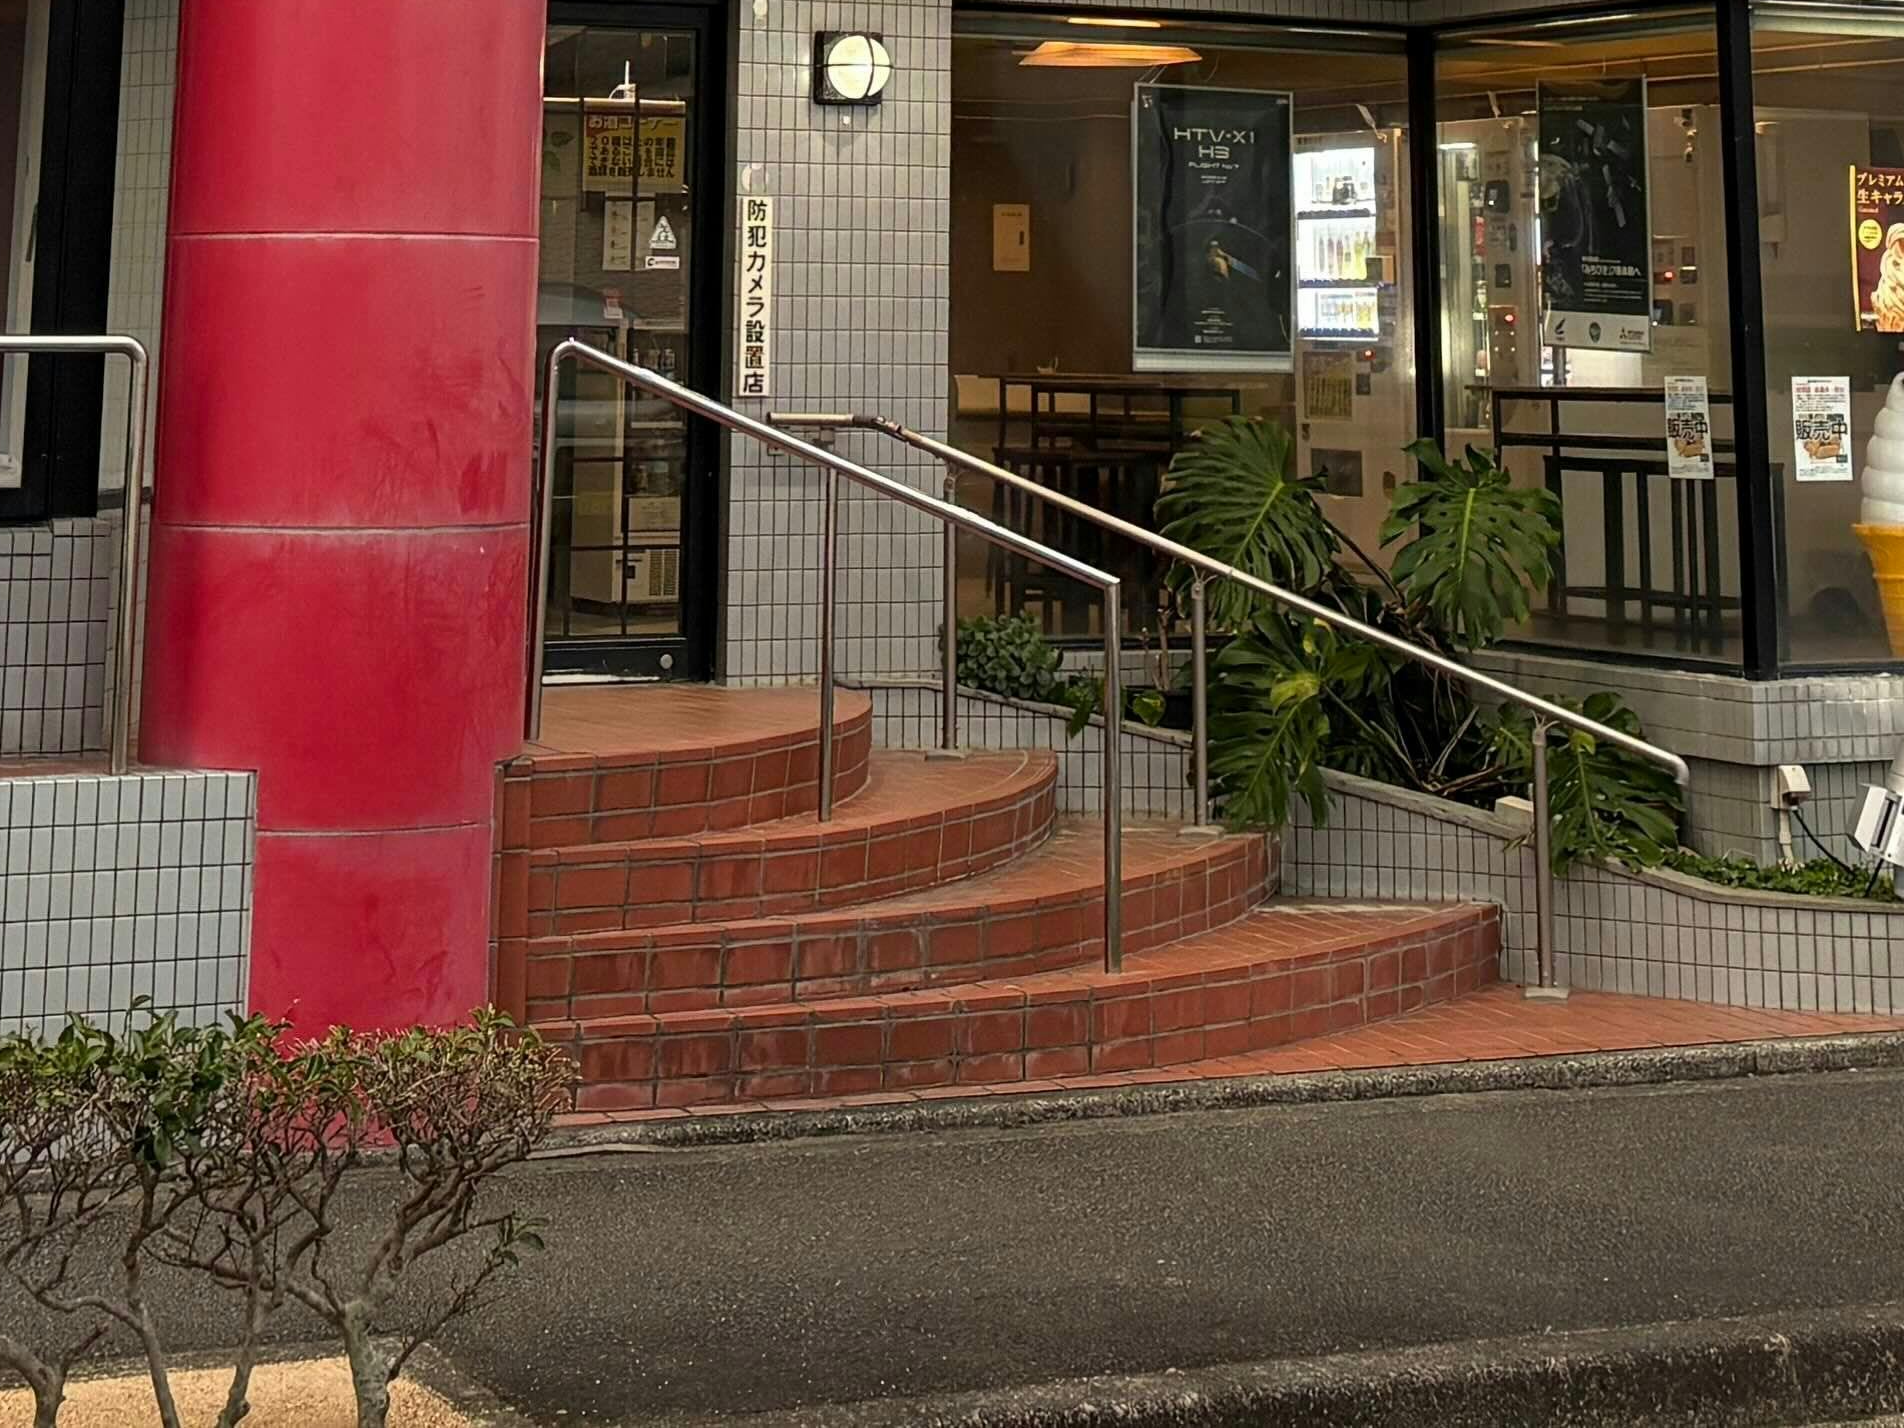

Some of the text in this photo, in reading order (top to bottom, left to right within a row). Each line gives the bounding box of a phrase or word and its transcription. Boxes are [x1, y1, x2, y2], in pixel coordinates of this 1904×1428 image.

[1198, 145, 1230, 159] H3
[743, 199, 768, 394] 防犯カメラ設置店
[1796, 419, 1848, 441] 販売中
